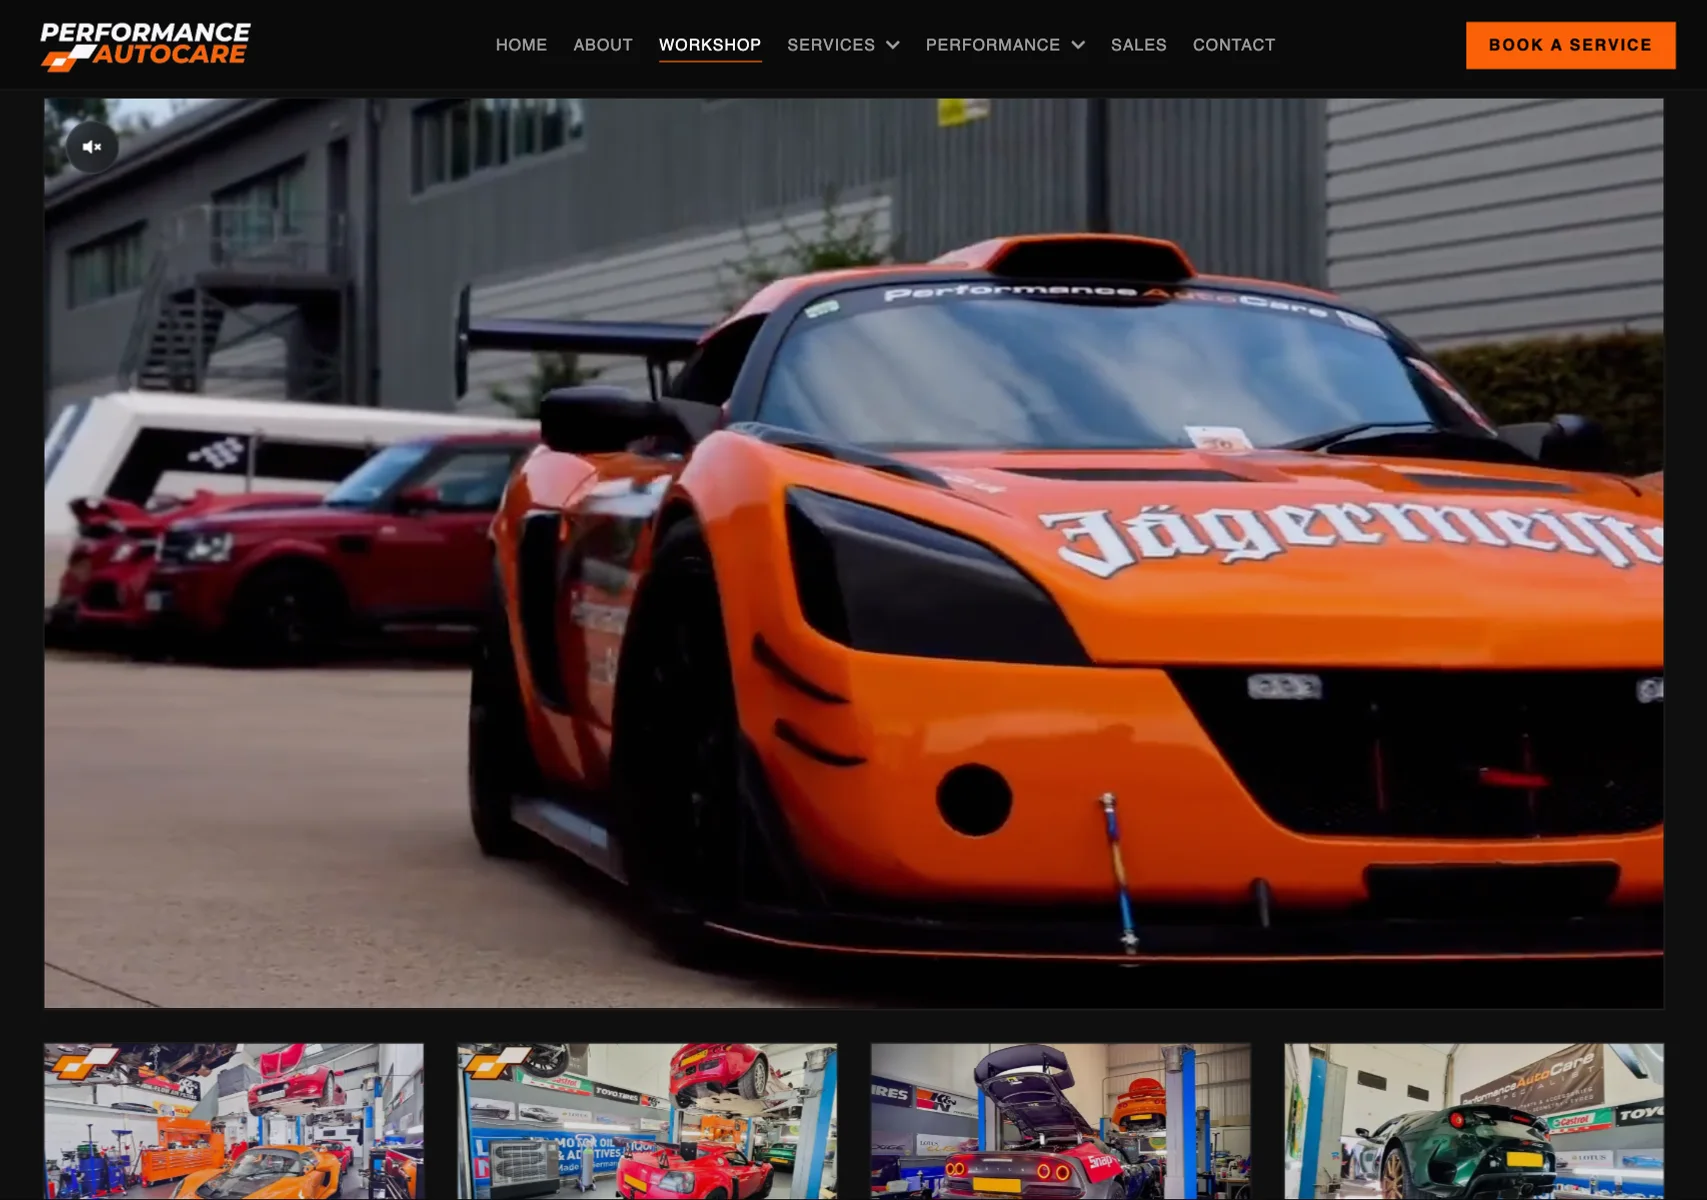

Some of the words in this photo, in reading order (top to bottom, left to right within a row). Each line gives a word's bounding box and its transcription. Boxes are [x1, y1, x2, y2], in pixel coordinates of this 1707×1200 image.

[40, 22, 252, 43] PERFORMANCE
[496, 37, 548, 52] HOME
[573, 37, 634, 52] ABOUT
[658, 37, 762, 52] WORKSHOP
[787, 37, 875, 52] SERVICES
[926, 37, 1060, 52] PERFORMANCE
[1111, 37, 1167, 52] SALES
[1192, 37, 1276, 52] CONTACT
[1489, 37, 1543, 52] BOOK
[1550, 38, 1563, 52] A
[1569, 37, 1652, 52] SERVICE
[92, 44, 248, 64] AUTOCARE
[596, 1086, 618, 1097] TOYO
[1559, 1114, 1590, 1127] Castrol
[567, 1149, 621, 1160] ADTIVES
